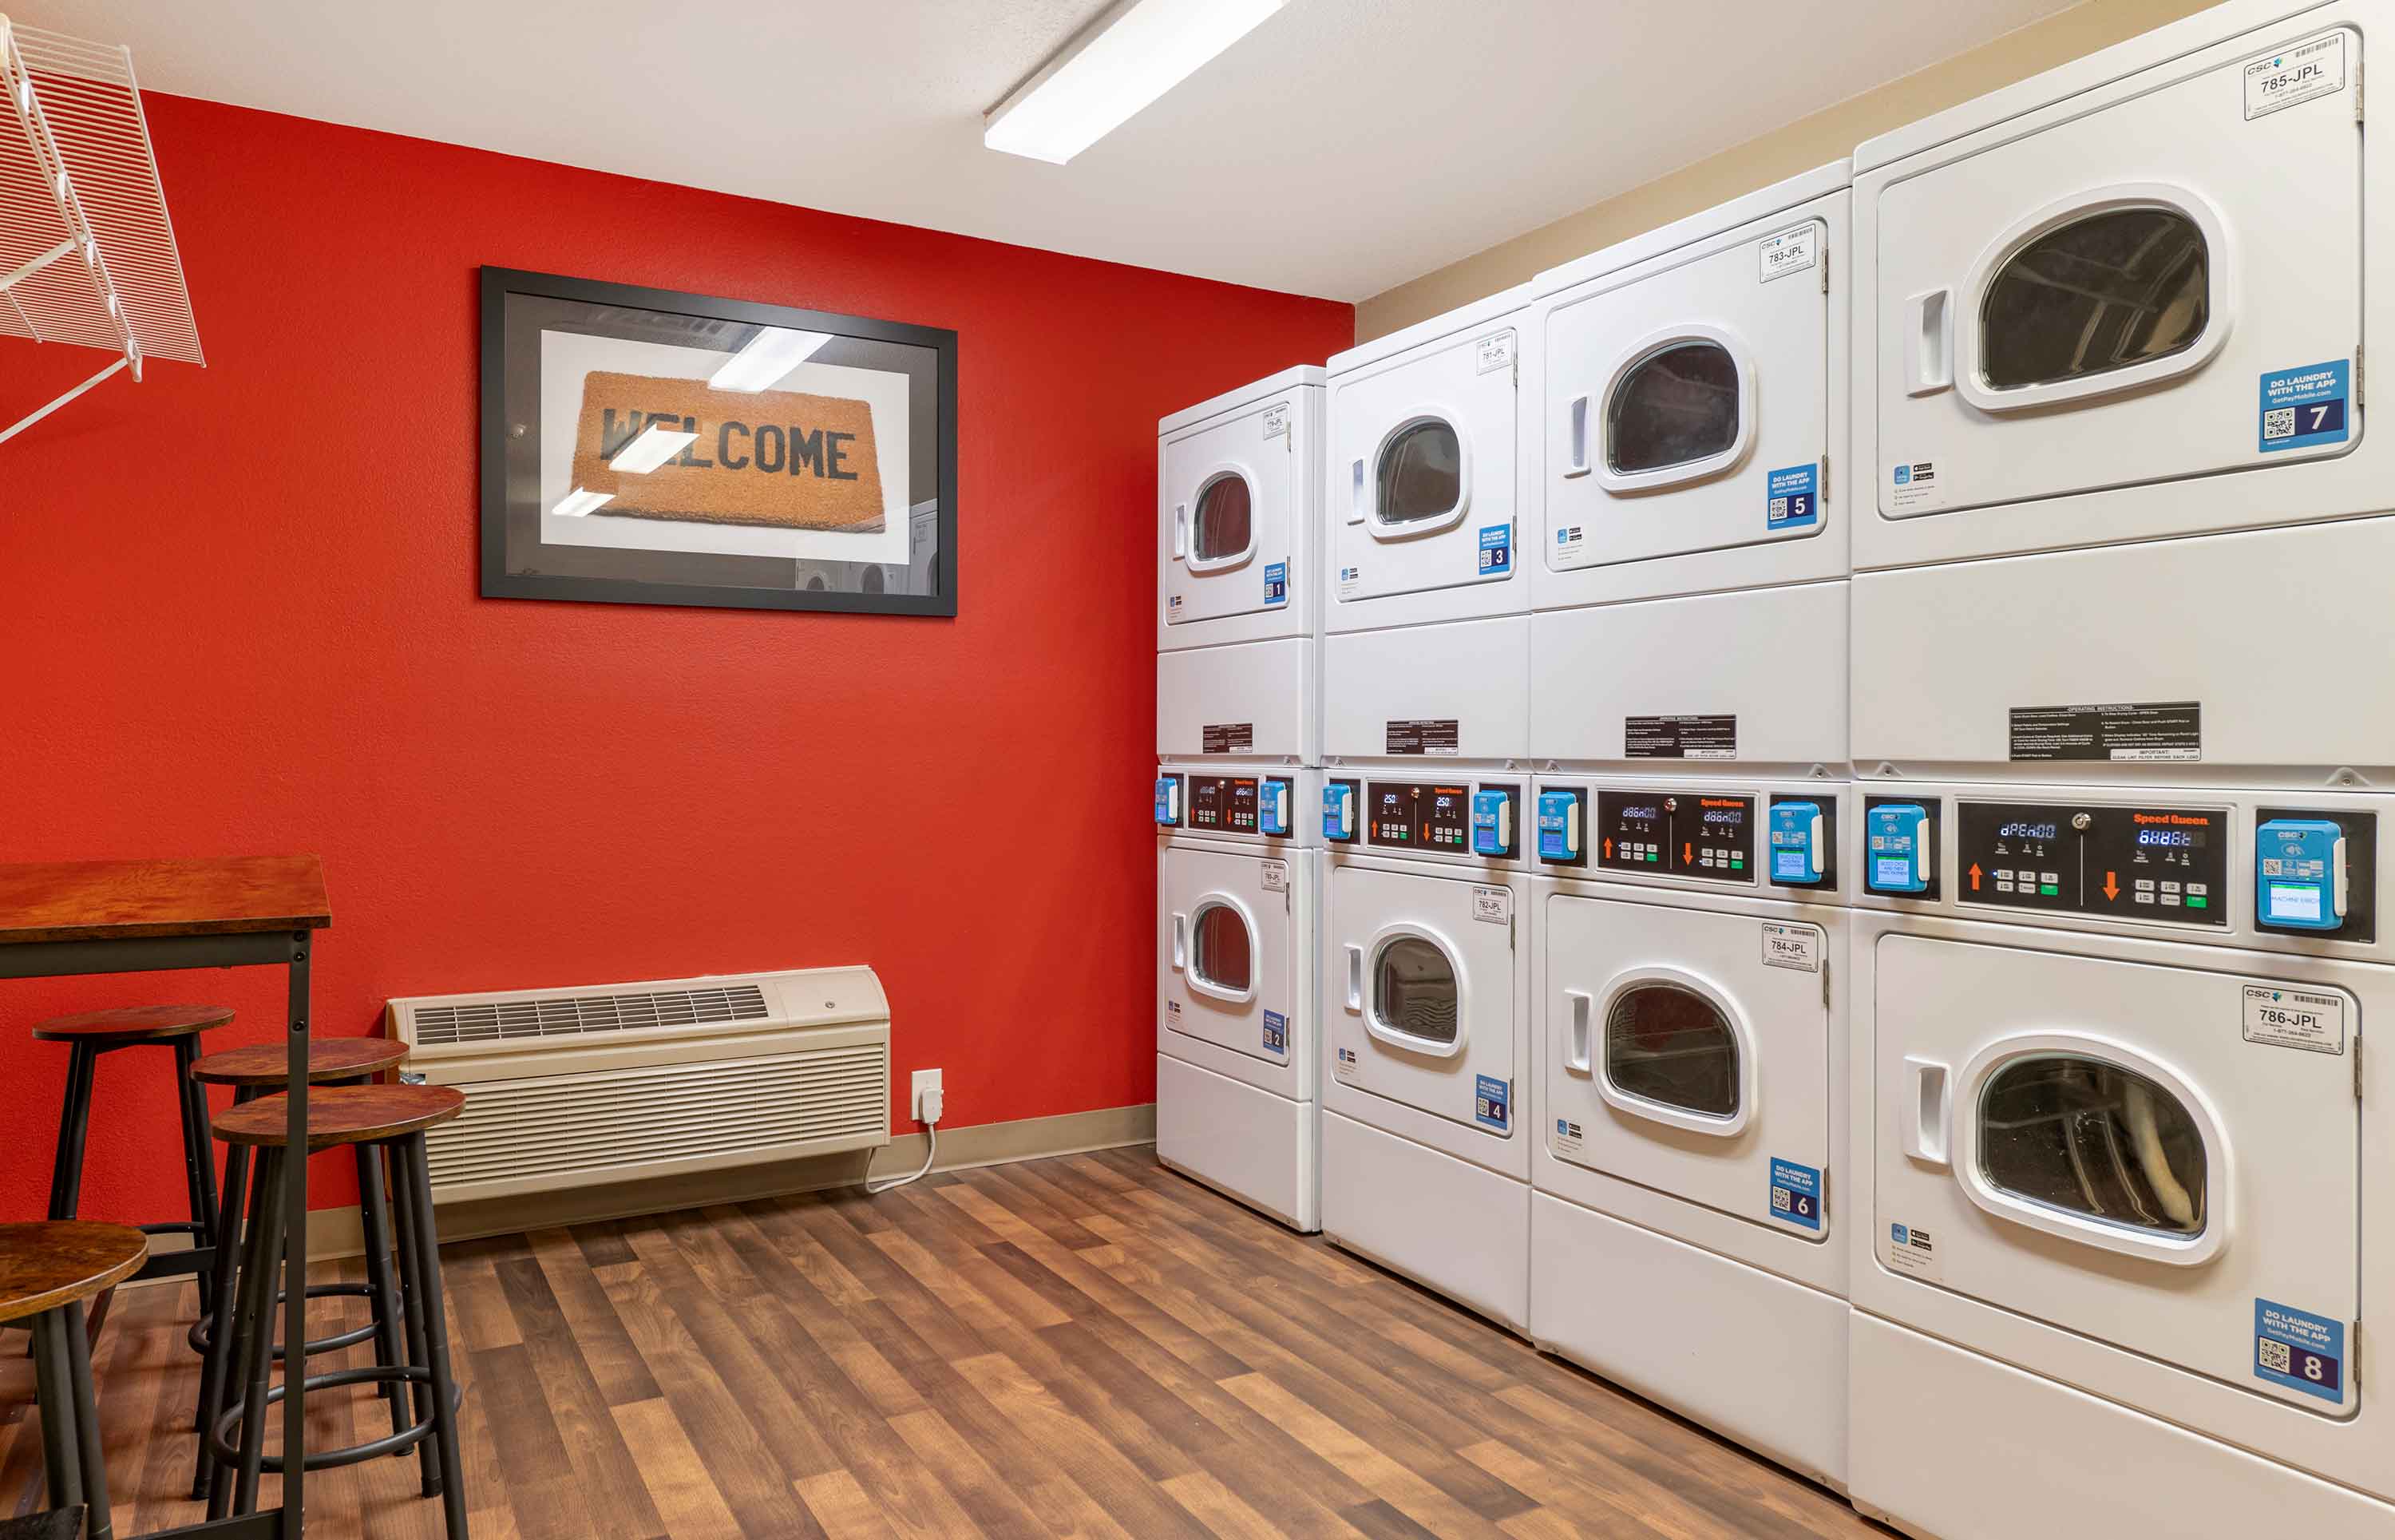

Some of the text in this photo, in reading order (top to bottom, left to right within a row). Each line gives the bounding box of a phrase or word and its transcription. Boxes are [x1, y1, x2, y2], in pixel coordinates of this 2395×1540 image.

[2247, 61, 2271, 75] CSC
[2261, 64, 2323, 93] 785-JPL
[1768, 246, 1804, 263] 783-JPL
[2268, 379, 2337, 397] WITH THE APP
[2270, 371, 2334, 388] DO LAUNDRY
[2310, 406, 2329, 430] 7
[600, 408, 859, 481] WELCOME
[1795, 497, 1806, 515] 5
[1496, 549, 1503, 564] 3
[1277, 583, 1281, 595] 1
[1700, 799, 1721, 808] Speed
[2133, 814, 2208, 825] Speed Queen
[1772, 940, 1806, 954] 784-JPL
[2246, 989, 2270, 999] CSC
[2259, 1009, 2322, 1029] 786-JPL
[1275, 1034, 1280, 1046] 2
[1493, 1104, 1501, 1118] 4
[1798, 1197, 1808, 1214] 6
[2262, 1316, 2332, 1342] WITH THE APP
[2266, 1309, 2328, 1333] DO LAUNDRY
[2304, 1356, 2323, 1380] 8
